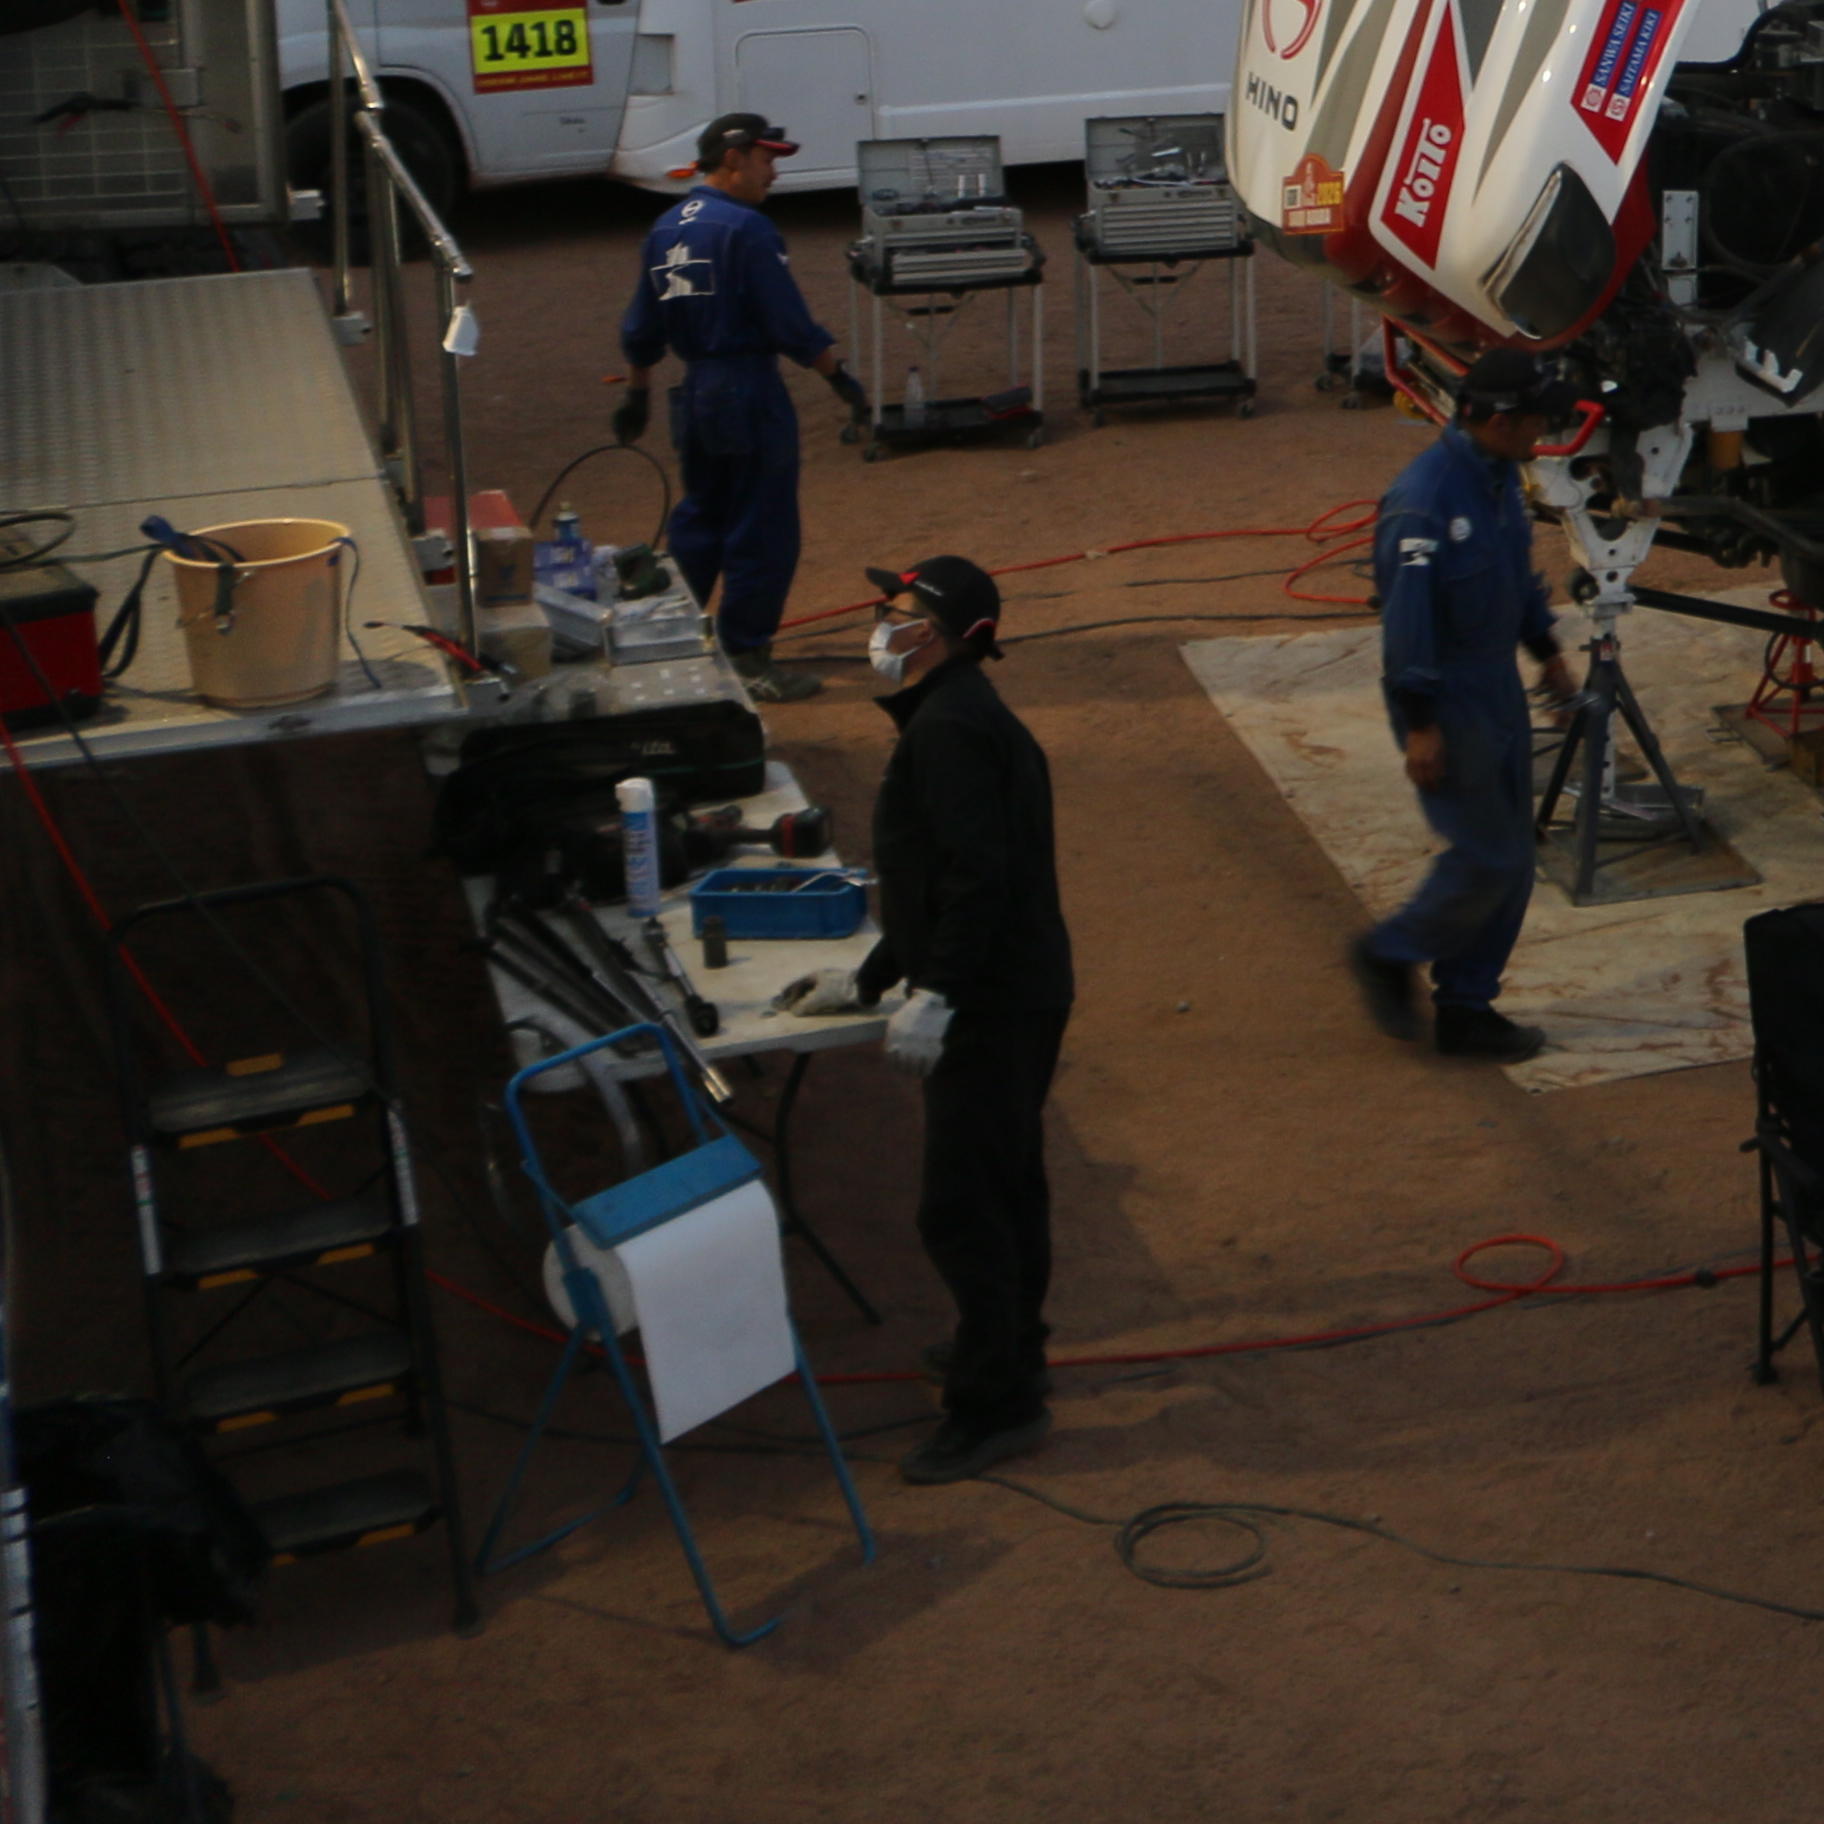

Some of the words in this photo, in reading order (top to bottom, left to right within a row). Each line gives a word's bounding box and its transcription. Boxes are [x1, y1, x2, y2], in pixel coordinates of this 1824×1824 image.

[481, 19, 578, 62] 1418
[1595, 31, 1621, 86] SANWA
[1620, 40, 1647, 95] SAITAMA
[1246, 70, 1299, 133] HINO
